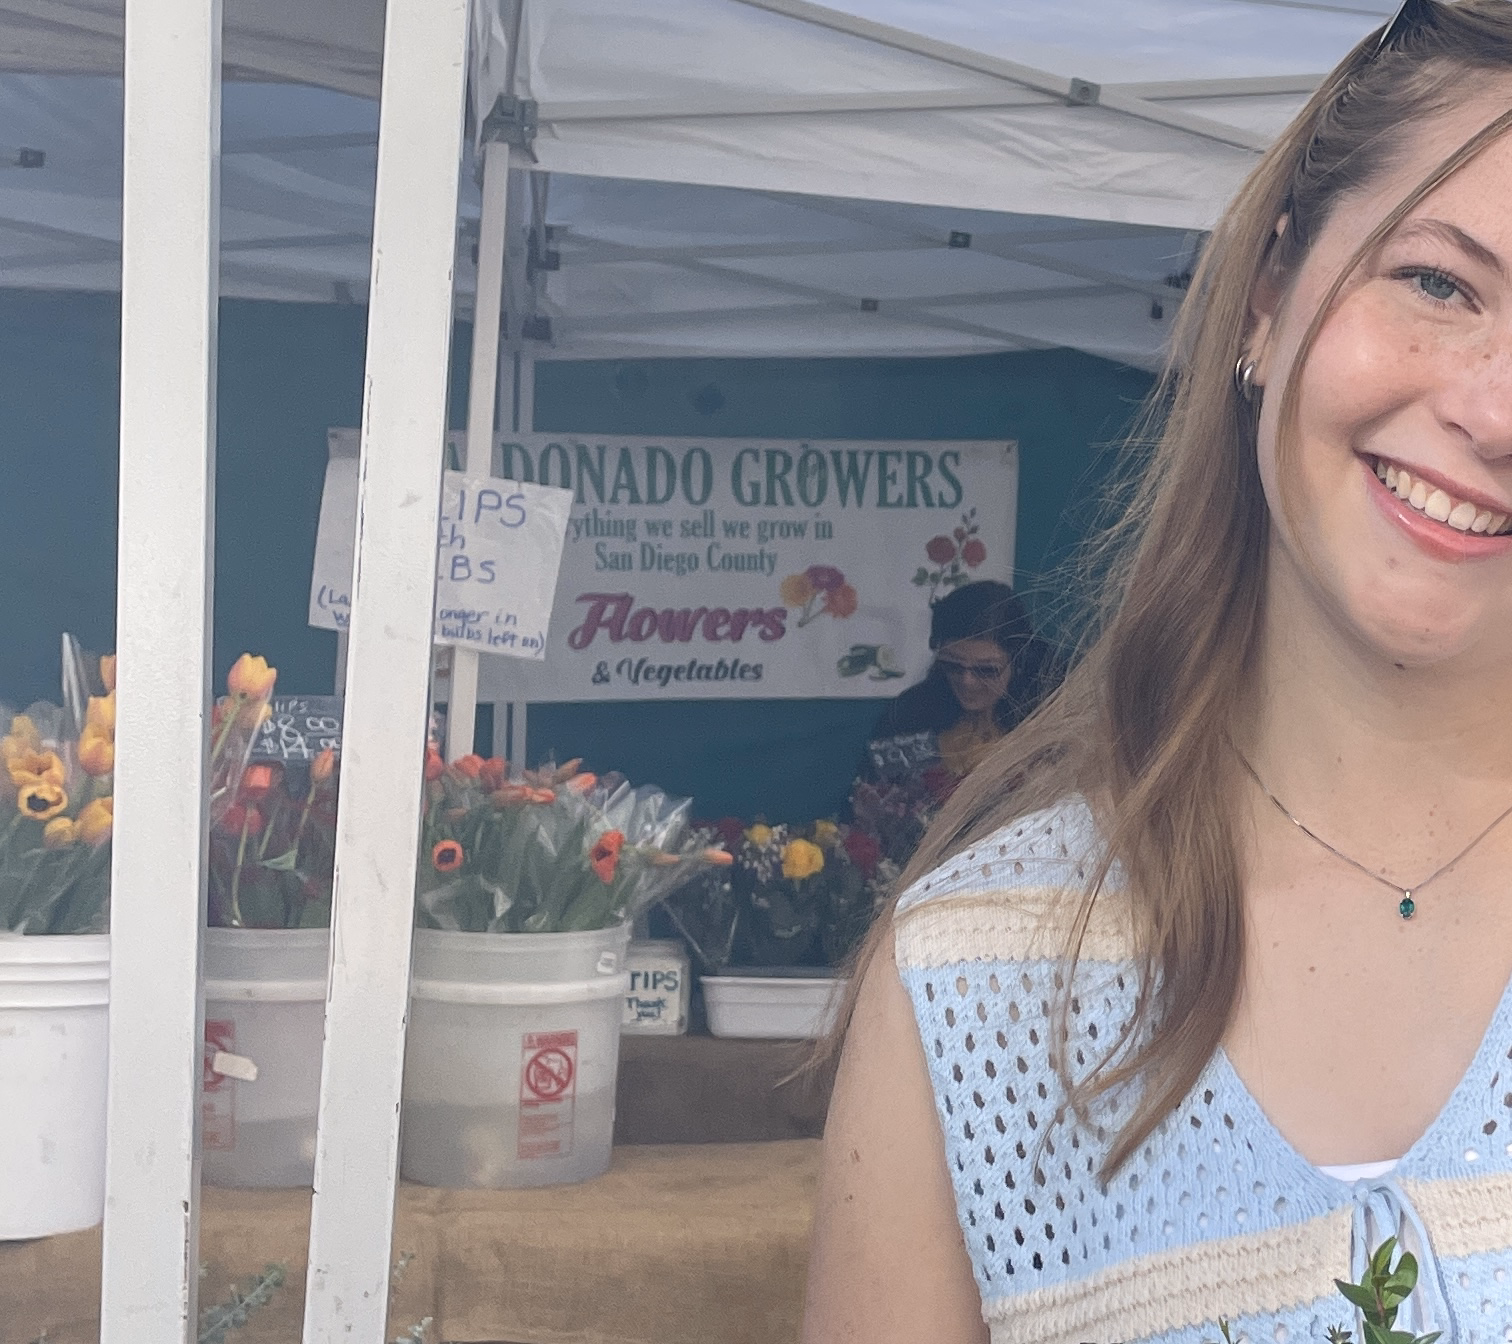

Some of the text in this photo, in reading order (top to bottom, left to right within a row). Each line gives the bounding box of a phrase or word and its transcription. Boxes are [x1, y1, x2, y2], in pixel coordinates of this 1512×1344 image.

[448, 440, 963, 508] DONADO GROWERS
[570, 508, 833, 545] ything we sell we grow in
[595, 541, 777, 577] San Diego County
[568, 592, 788, 650] Flowers
[592, 657, 764, 688] & Vegetables
